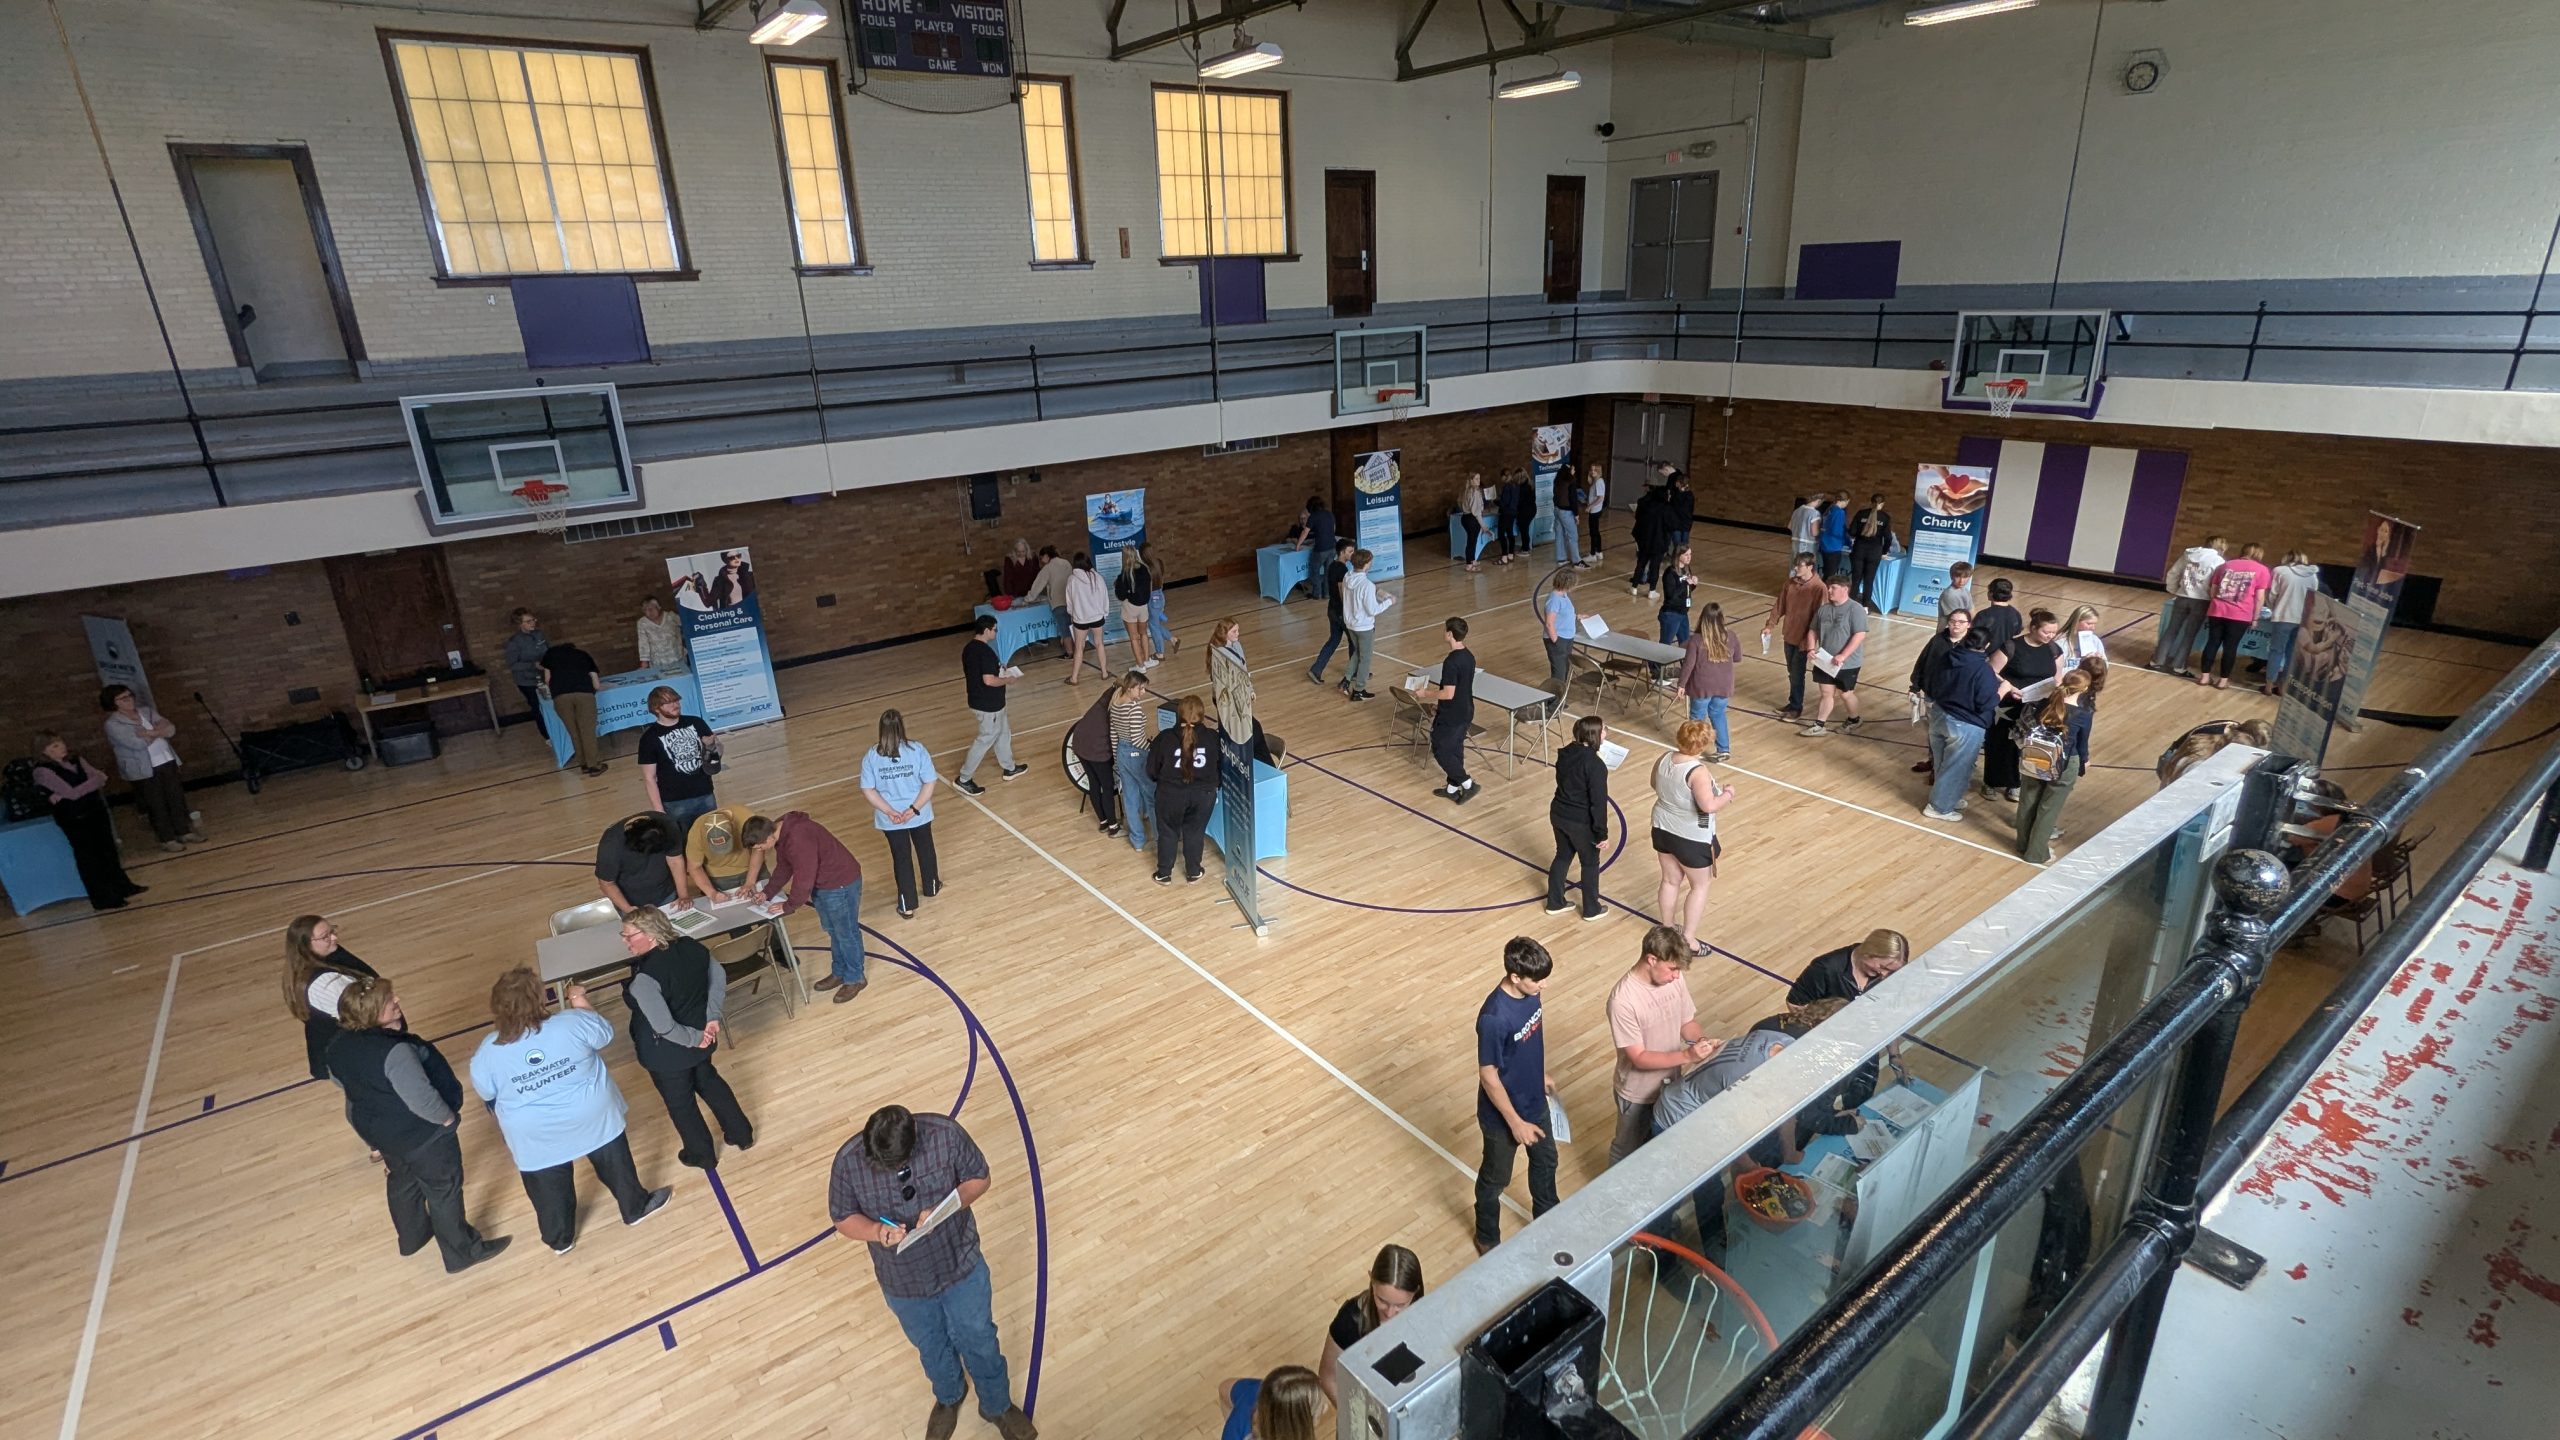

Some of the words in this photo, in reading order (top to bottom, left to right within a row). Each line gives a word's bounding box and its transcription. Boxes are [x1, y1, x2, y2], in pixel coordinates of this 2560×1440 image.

[862, 0, 914, 14] HOME
[951, 4, 1005, 22] VISITOR
[860, 13, 897, 28] FOULS
[915, 19, 954, 33] PLAYER
[972, 24, 1005, 37] FOULS
[872, 54, 897, 67] WON
[928, 58, 957, 71] GAME
[981, 62, 1004, 74] WON
[1366, 495, 1395, 506] Leisure
[1921, 514, 1971, 532] Charity
[698, 610, 736, 621] Clothing
[737, 607, 743, 615] &
[694, 619, 732, 631] Personal
[733, 616, 753, 624] Care
[1220, 737, 1250, 781] Surprise!
[880, 771, 914, 780] VOLUNTEER
[511, 1056, 571, 1084] BREAKWATER
[516, 1064, 577, 1095] VOLUNTEER
